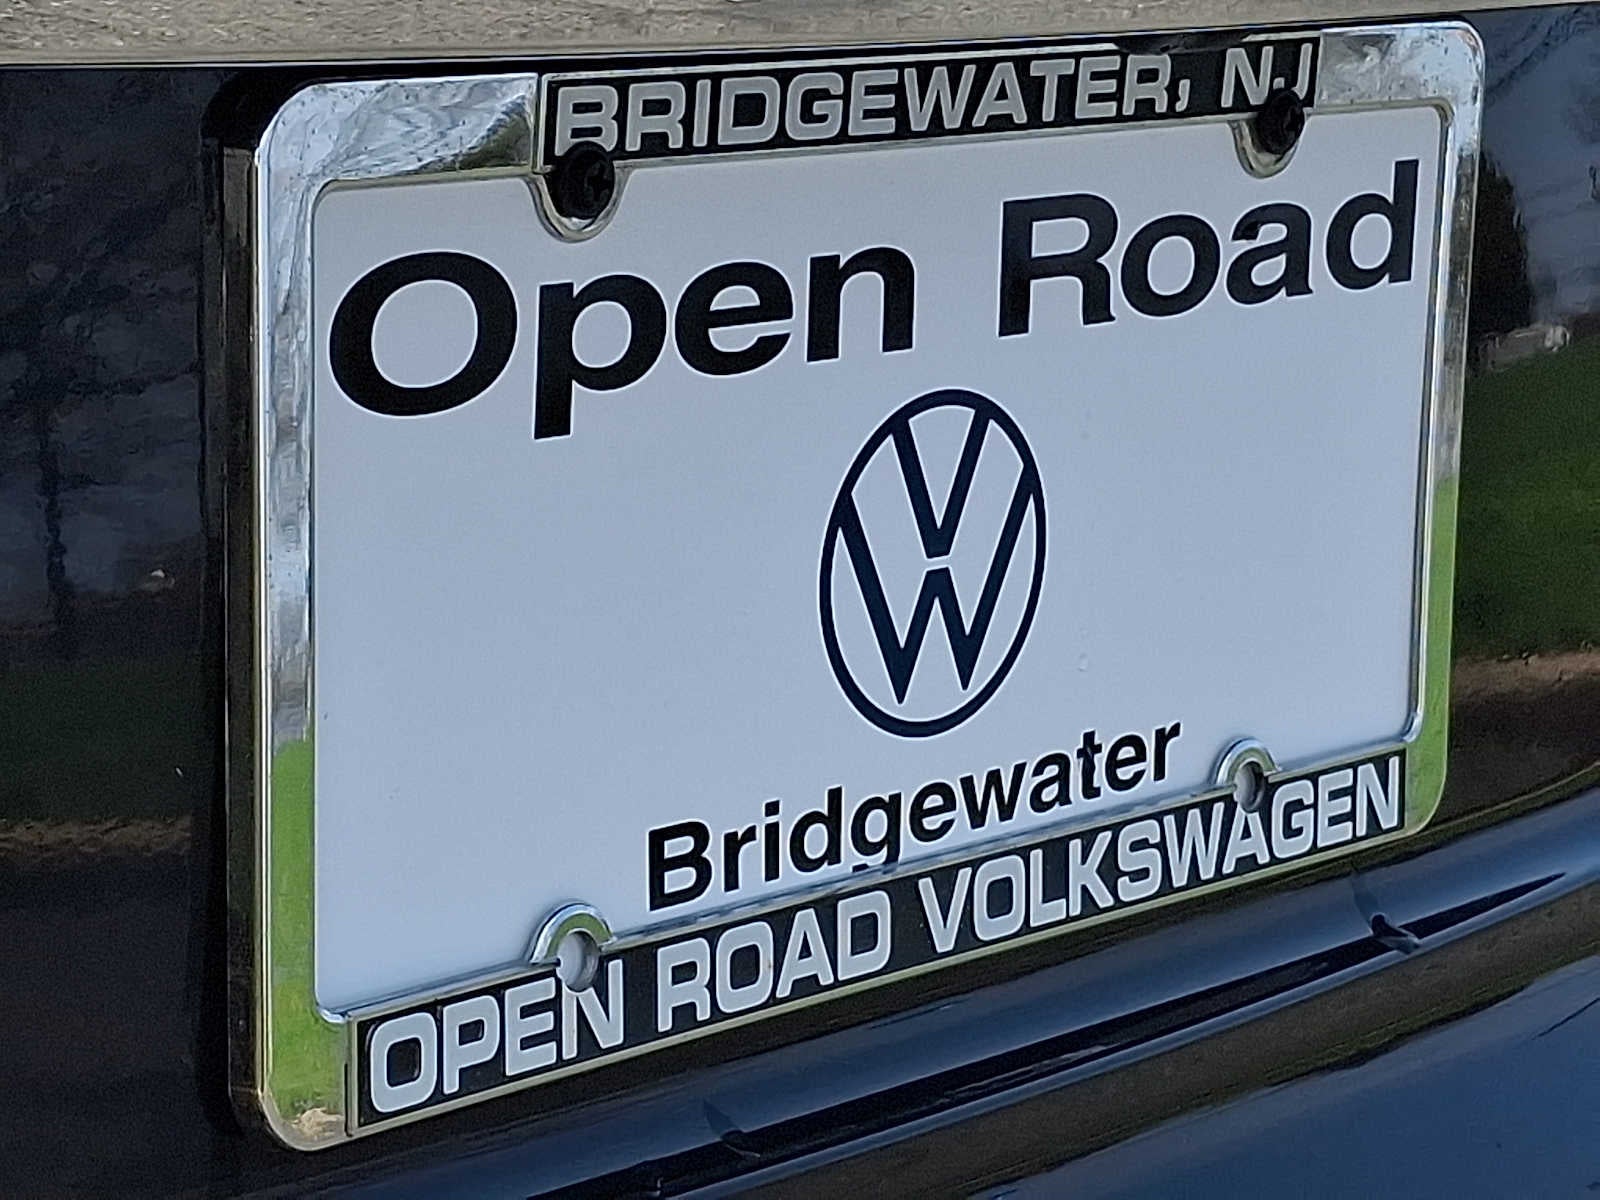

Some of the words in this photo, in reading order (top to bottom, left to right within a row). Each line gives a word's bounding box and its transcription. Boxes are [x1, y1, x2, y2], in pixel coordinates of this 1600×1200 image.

[554, 54, 1191, 156] BRIDGEWATER,
[329, 247, 916, 438] Open
[1000, 159, 1418, 336] Road
[649, 722, 1181, 911] Bridgewater
[370, 958, 625, 1113] OPEN
[656, 890, 891, 1032] ROAD
[917, 756, 1399, 953] VOLKSWAGEN
